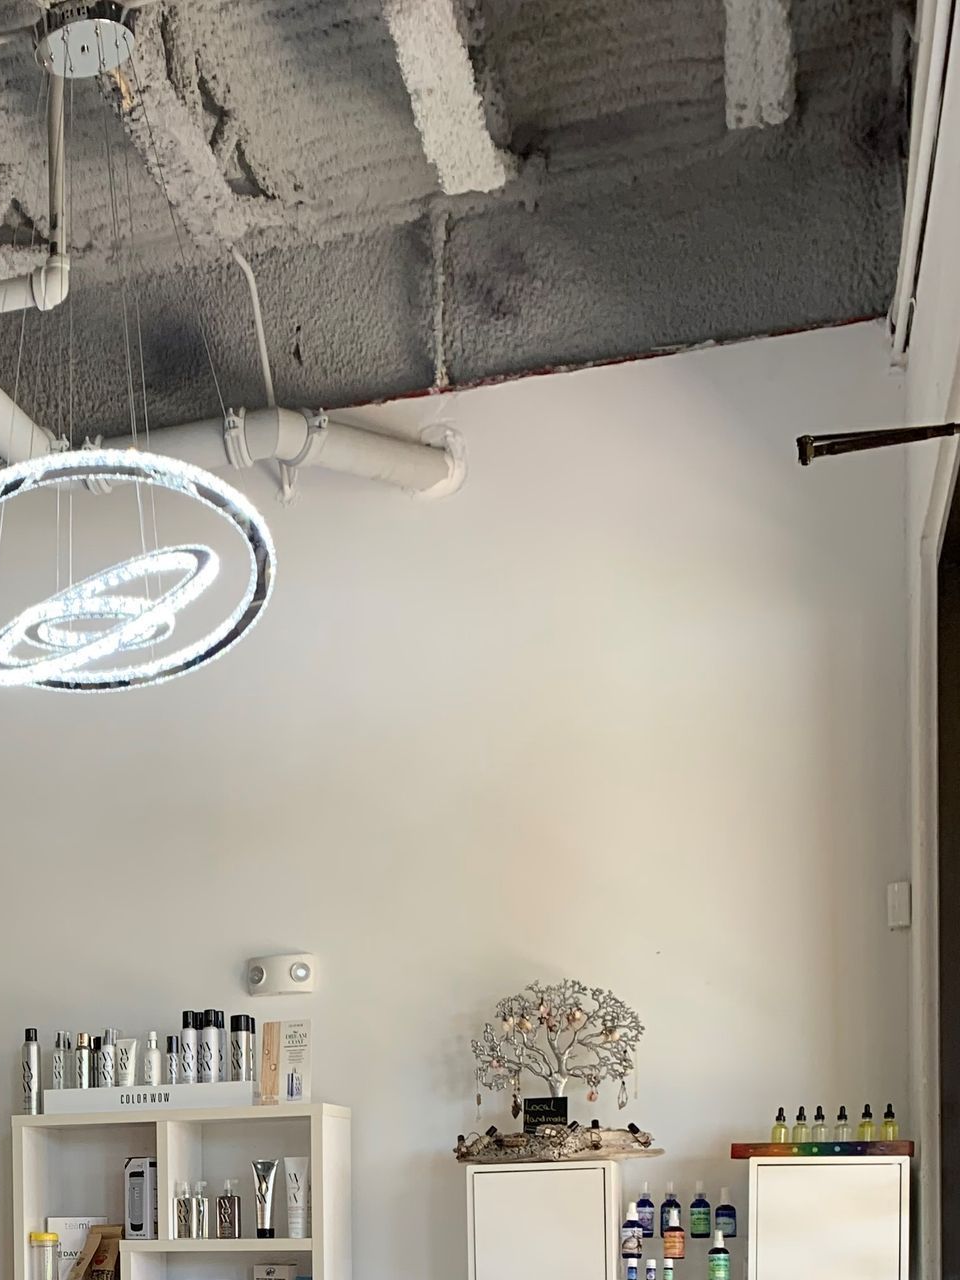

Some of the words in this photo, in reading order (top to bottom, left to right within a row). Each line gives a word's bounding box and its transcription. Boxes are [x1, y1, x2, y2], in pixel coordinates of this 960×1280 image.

[120, 1093, 148, 1105] COLOR
[150, 1092, 170, 1103] WOW
[63, 1250, 79, 1258] DAY
